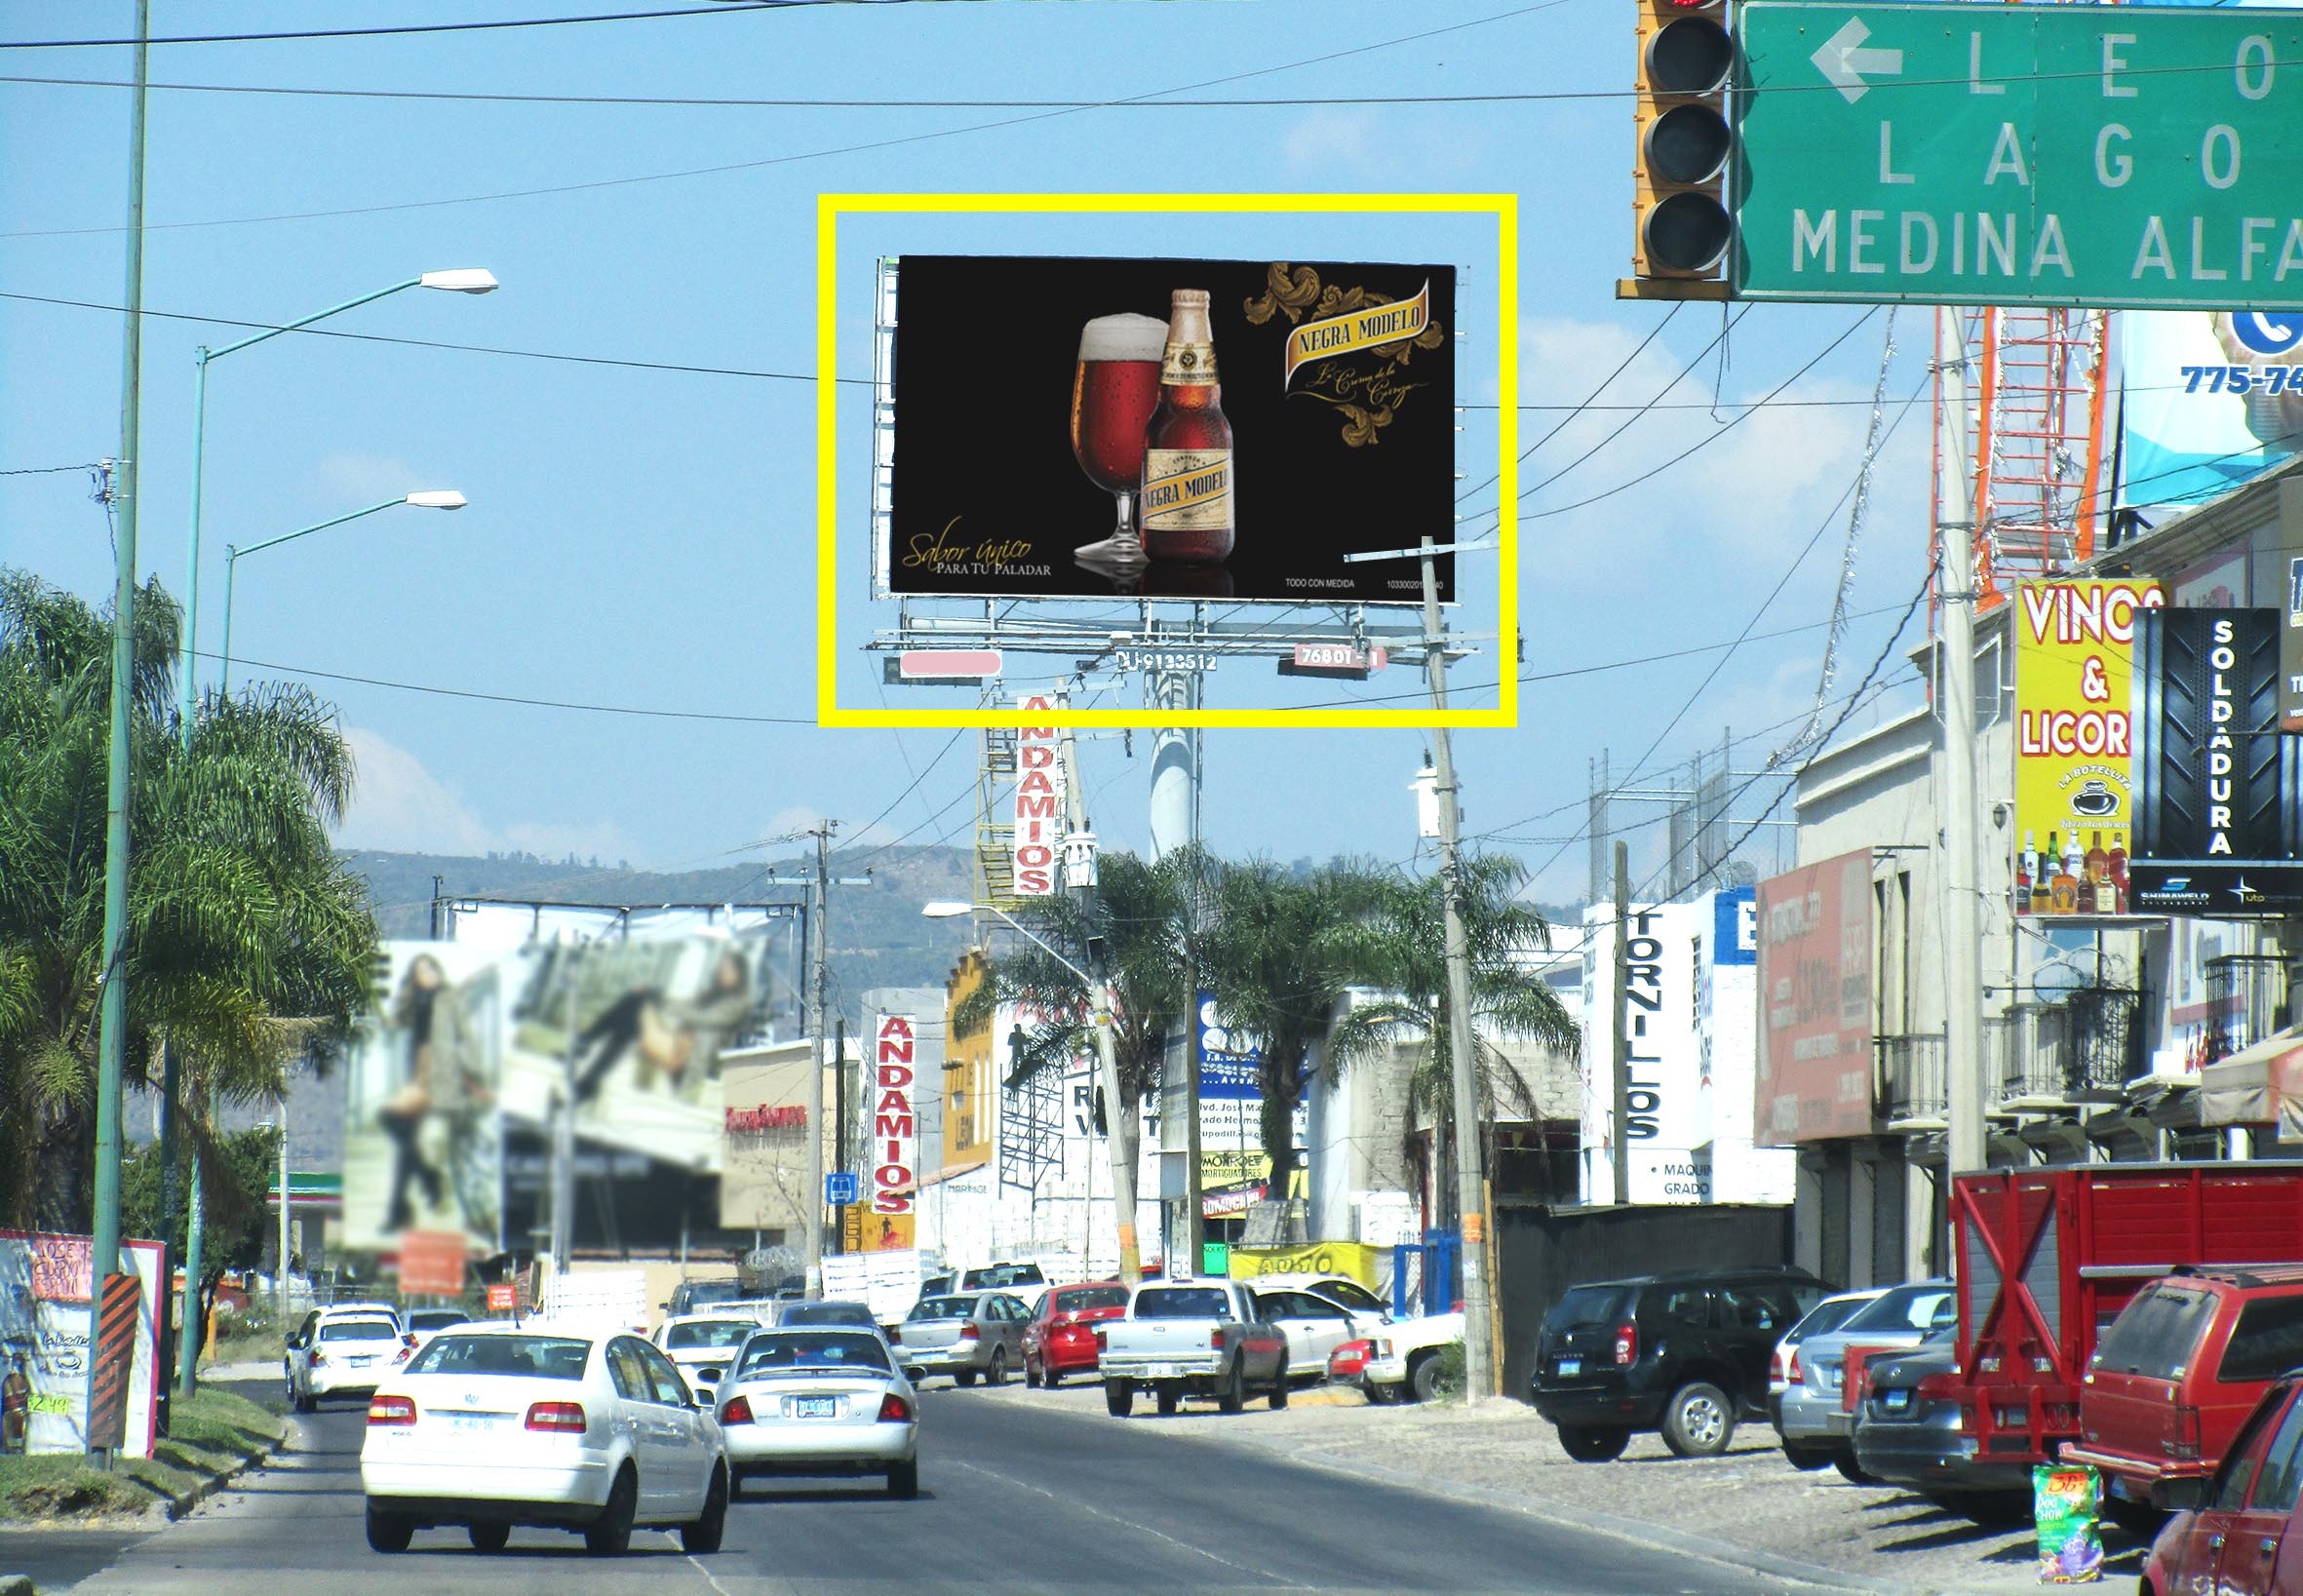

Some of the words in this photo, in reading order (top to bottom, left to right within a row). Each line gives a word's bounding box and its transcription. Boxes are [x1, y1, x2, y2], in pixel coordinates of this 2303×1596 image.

[1791, 209, 2075, 278] MEDINA
[1298, 323, 1351, 354] NEGRA
[1358, 306, 1421, 340] MODELO
[902, 516, 971, 570] Sabor
[976, 538, 1032, 565] único
[936, 562, 969, 574] PARA
[971, 563, 990, 574] TU
[994, 563, 1052, 575] PALADAR
[1285, 578, 1307, 588] TODO
[1308, 578, 1325, 588] CON
[1325, 579, 1355, 589] MEDIDA
[2082, 655, 2111, 703] &
[2021, 710, 2132, 758] LICOR
[2209, 619, 2236, 855] SOLDADURA
[1016, 696, 1055, 892] ANDAMIOS
[2057, 772, 2074, 790] LA
[2072, 763, 2133, 792] BOTELLITA
[1625, 913, 1663, 1140] TORNILLOS
[874, 1016, 915, 1213] ANDAMIOS
[1199, 1103, 1219, 1112] lvd.
[1663, 1183, 1710, 1195] GRADO
